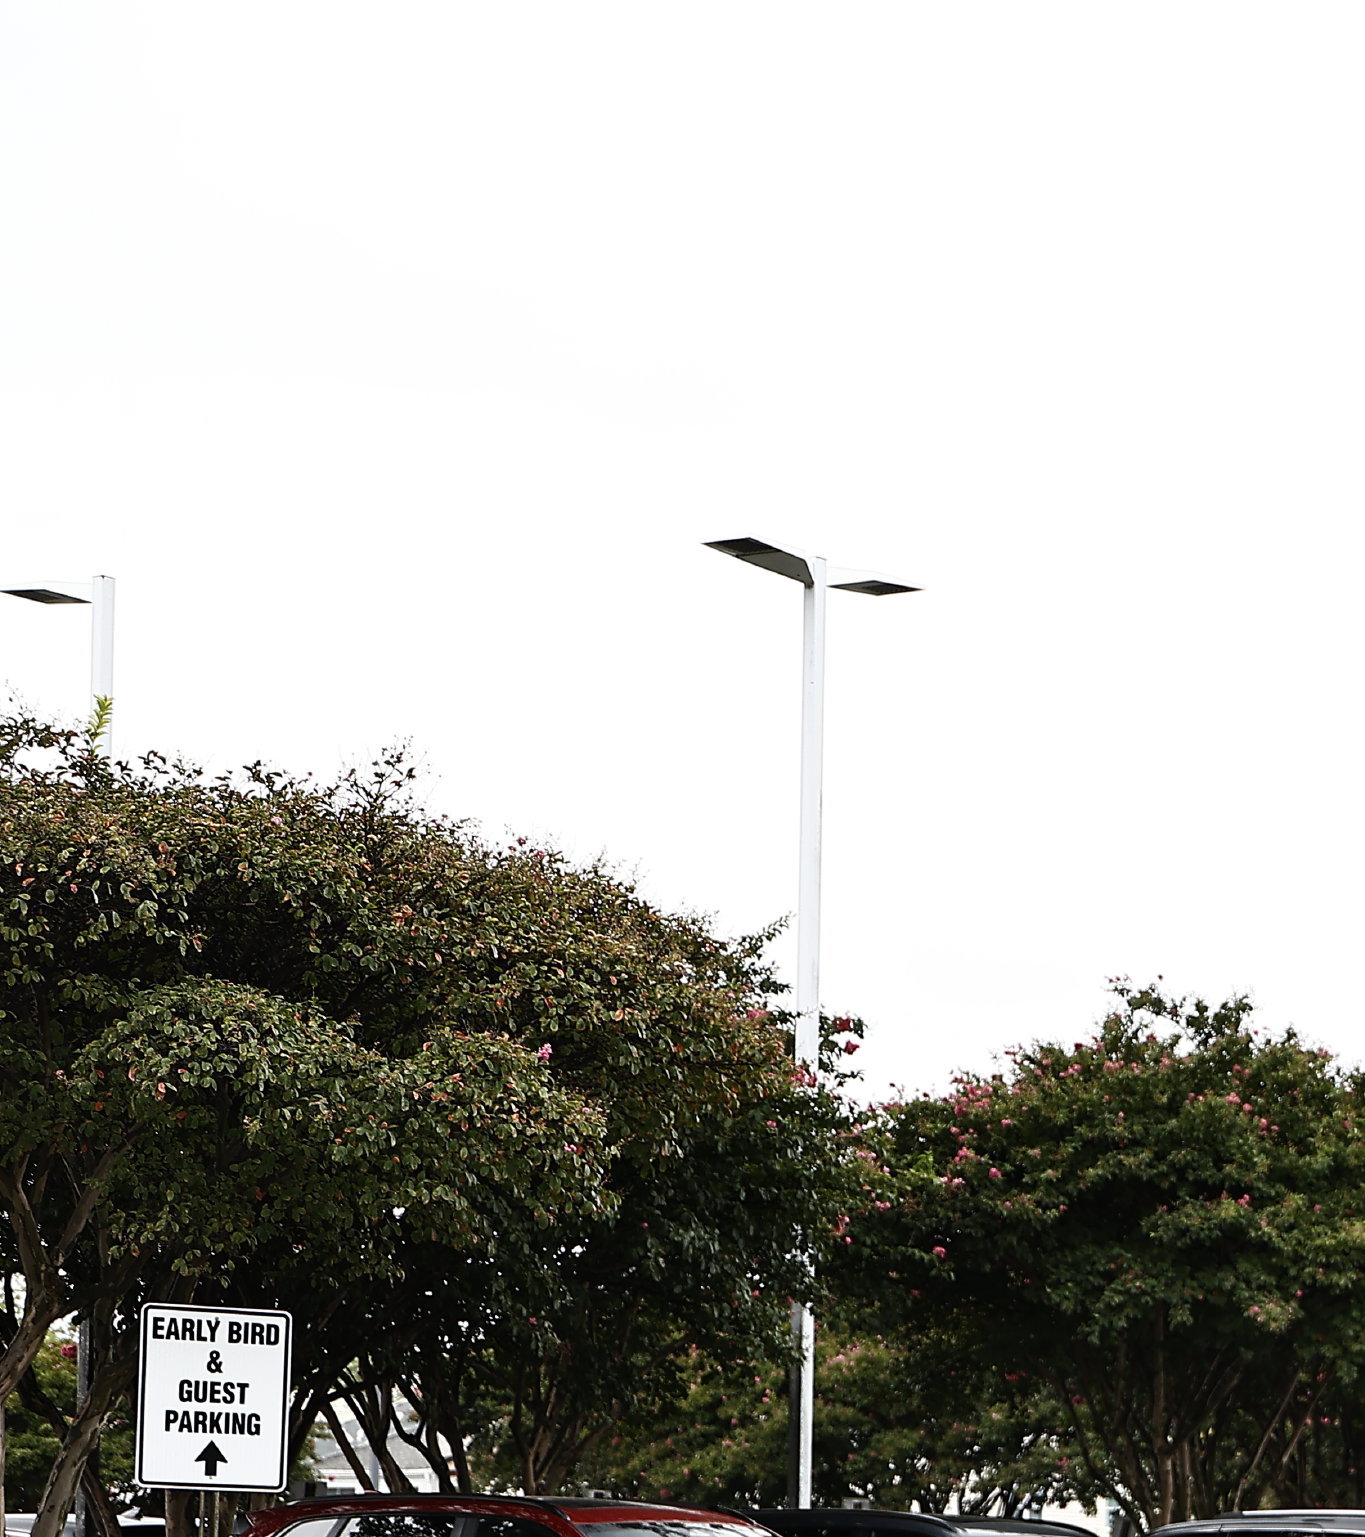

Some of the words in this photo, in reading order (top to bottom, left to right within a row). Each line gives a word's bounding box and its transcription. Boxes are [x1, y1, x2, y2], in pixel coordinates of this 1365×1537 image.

[152, 1316, 221, 1343] EARLY
[228, 1321, 280, 1346] BIRD
[206, 1350, 223, 1374] &
[178, 1379, 250, 1405] GUEST
[164, 1409, 261, 1436] PARKING
